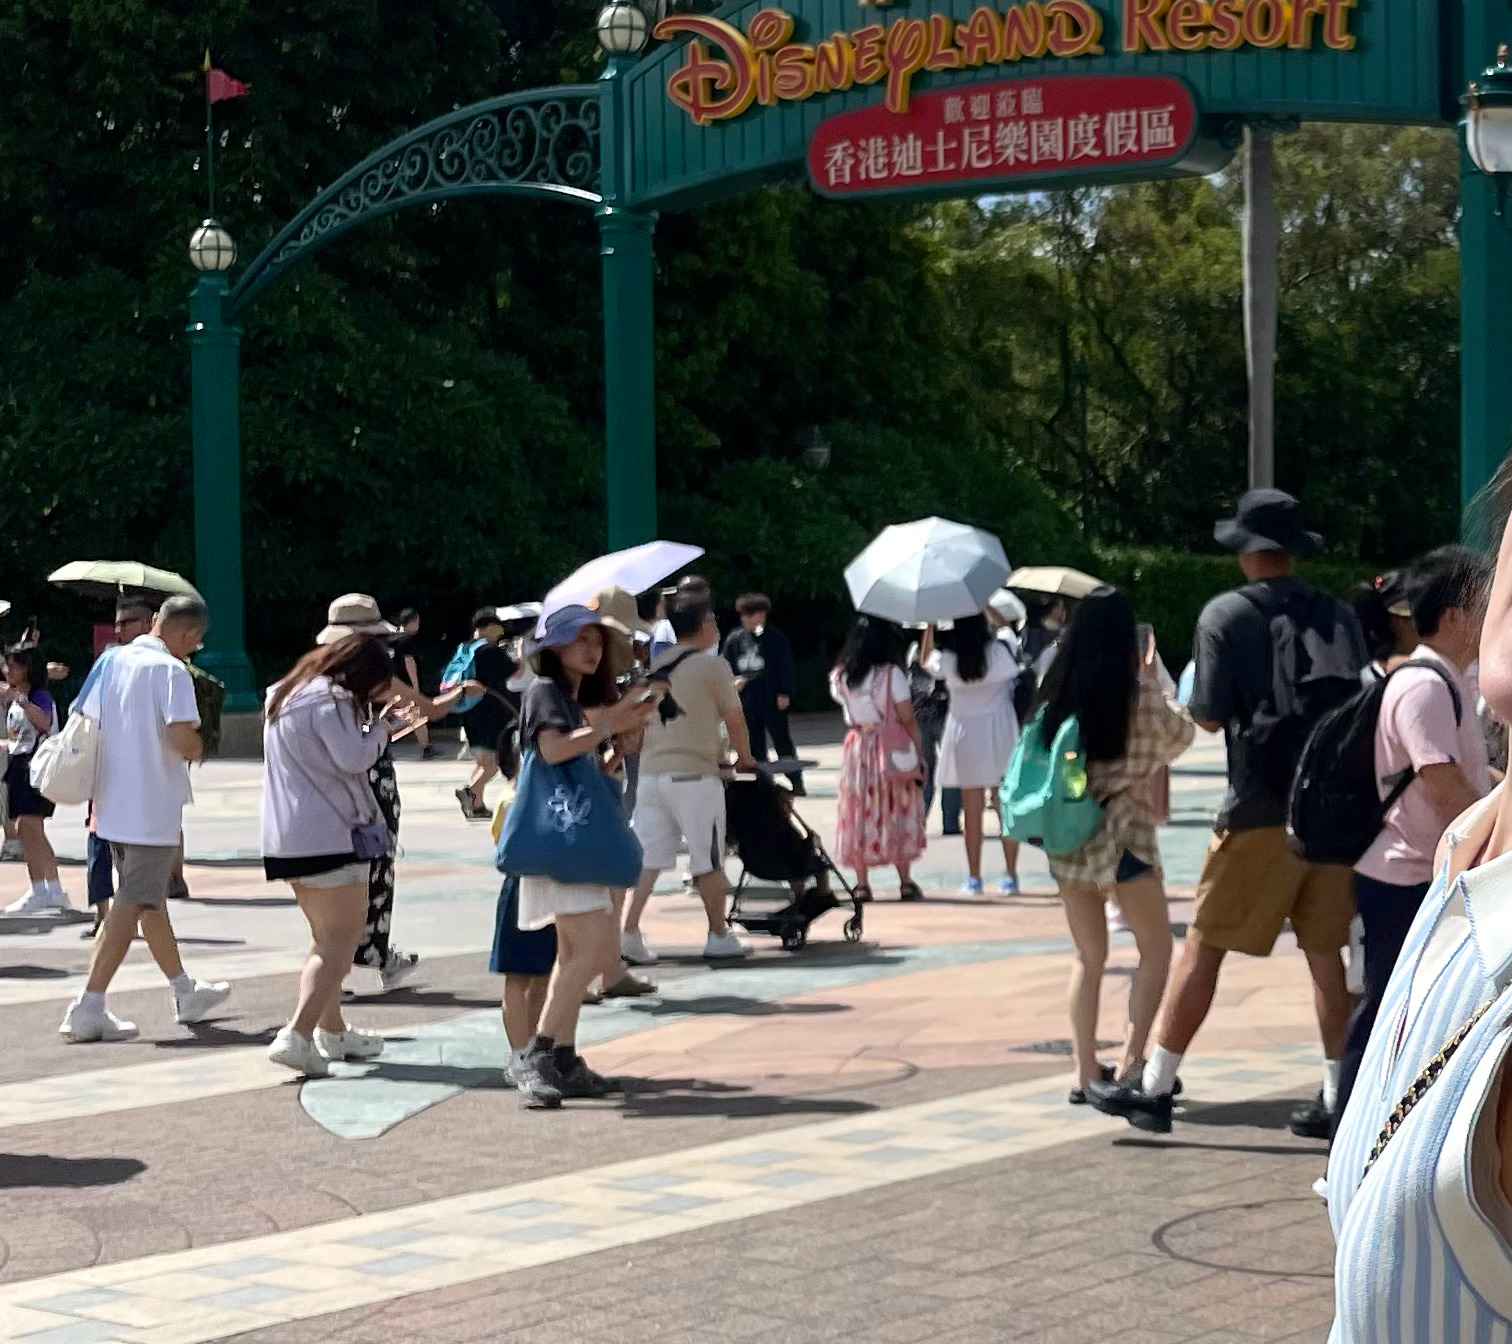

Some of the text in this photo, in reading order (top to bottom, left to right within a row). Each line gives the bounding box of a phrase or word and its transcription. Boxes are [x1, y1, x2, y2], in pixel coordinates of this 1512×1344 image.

[824, 105, 1176, 186] 香港迪士尼樂園度假區
